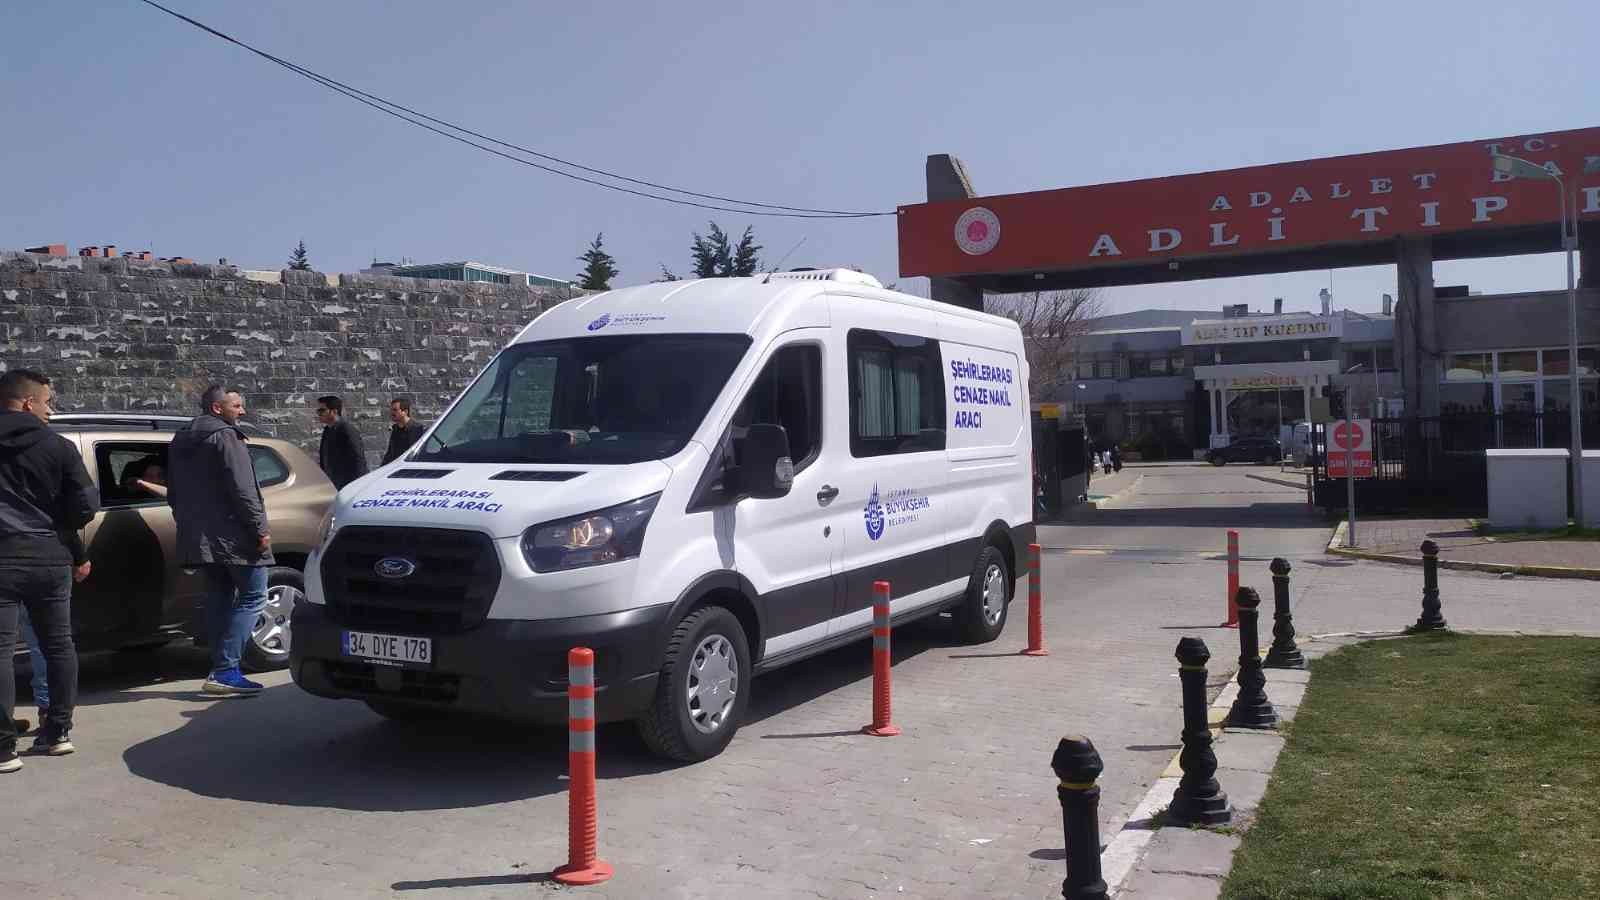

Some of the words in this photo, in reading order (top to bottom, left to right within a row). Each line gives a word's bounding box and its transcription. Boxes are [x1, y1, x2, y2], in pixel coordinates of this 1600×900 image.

[1208, 171, 1437, 212] ADALET
[1089, 207, 1286, 257] ADLİ
[1351, 195, 1508, 232] TIP
[1233, 326, 1258, 338] TIP
[951, 357, 1013, 384] ŞEHİRLERARASI
[954, 386, 989, 405] CENAZE
[989, 386, 1011, 406] NAKİL
[955, 410, 982, 428] ARACI
[381, 488, 494, 499] ŞEHİRLERARASI
[352, 499, 405, 509] CENAZE
[406, 498, 450, 509] NAKİL
[452, 501, 503, 512] ARACI
[350, 633, 366, 654] 34
[373, 636, 398, 658] DYE
[404, 639, 428, 660] 178
